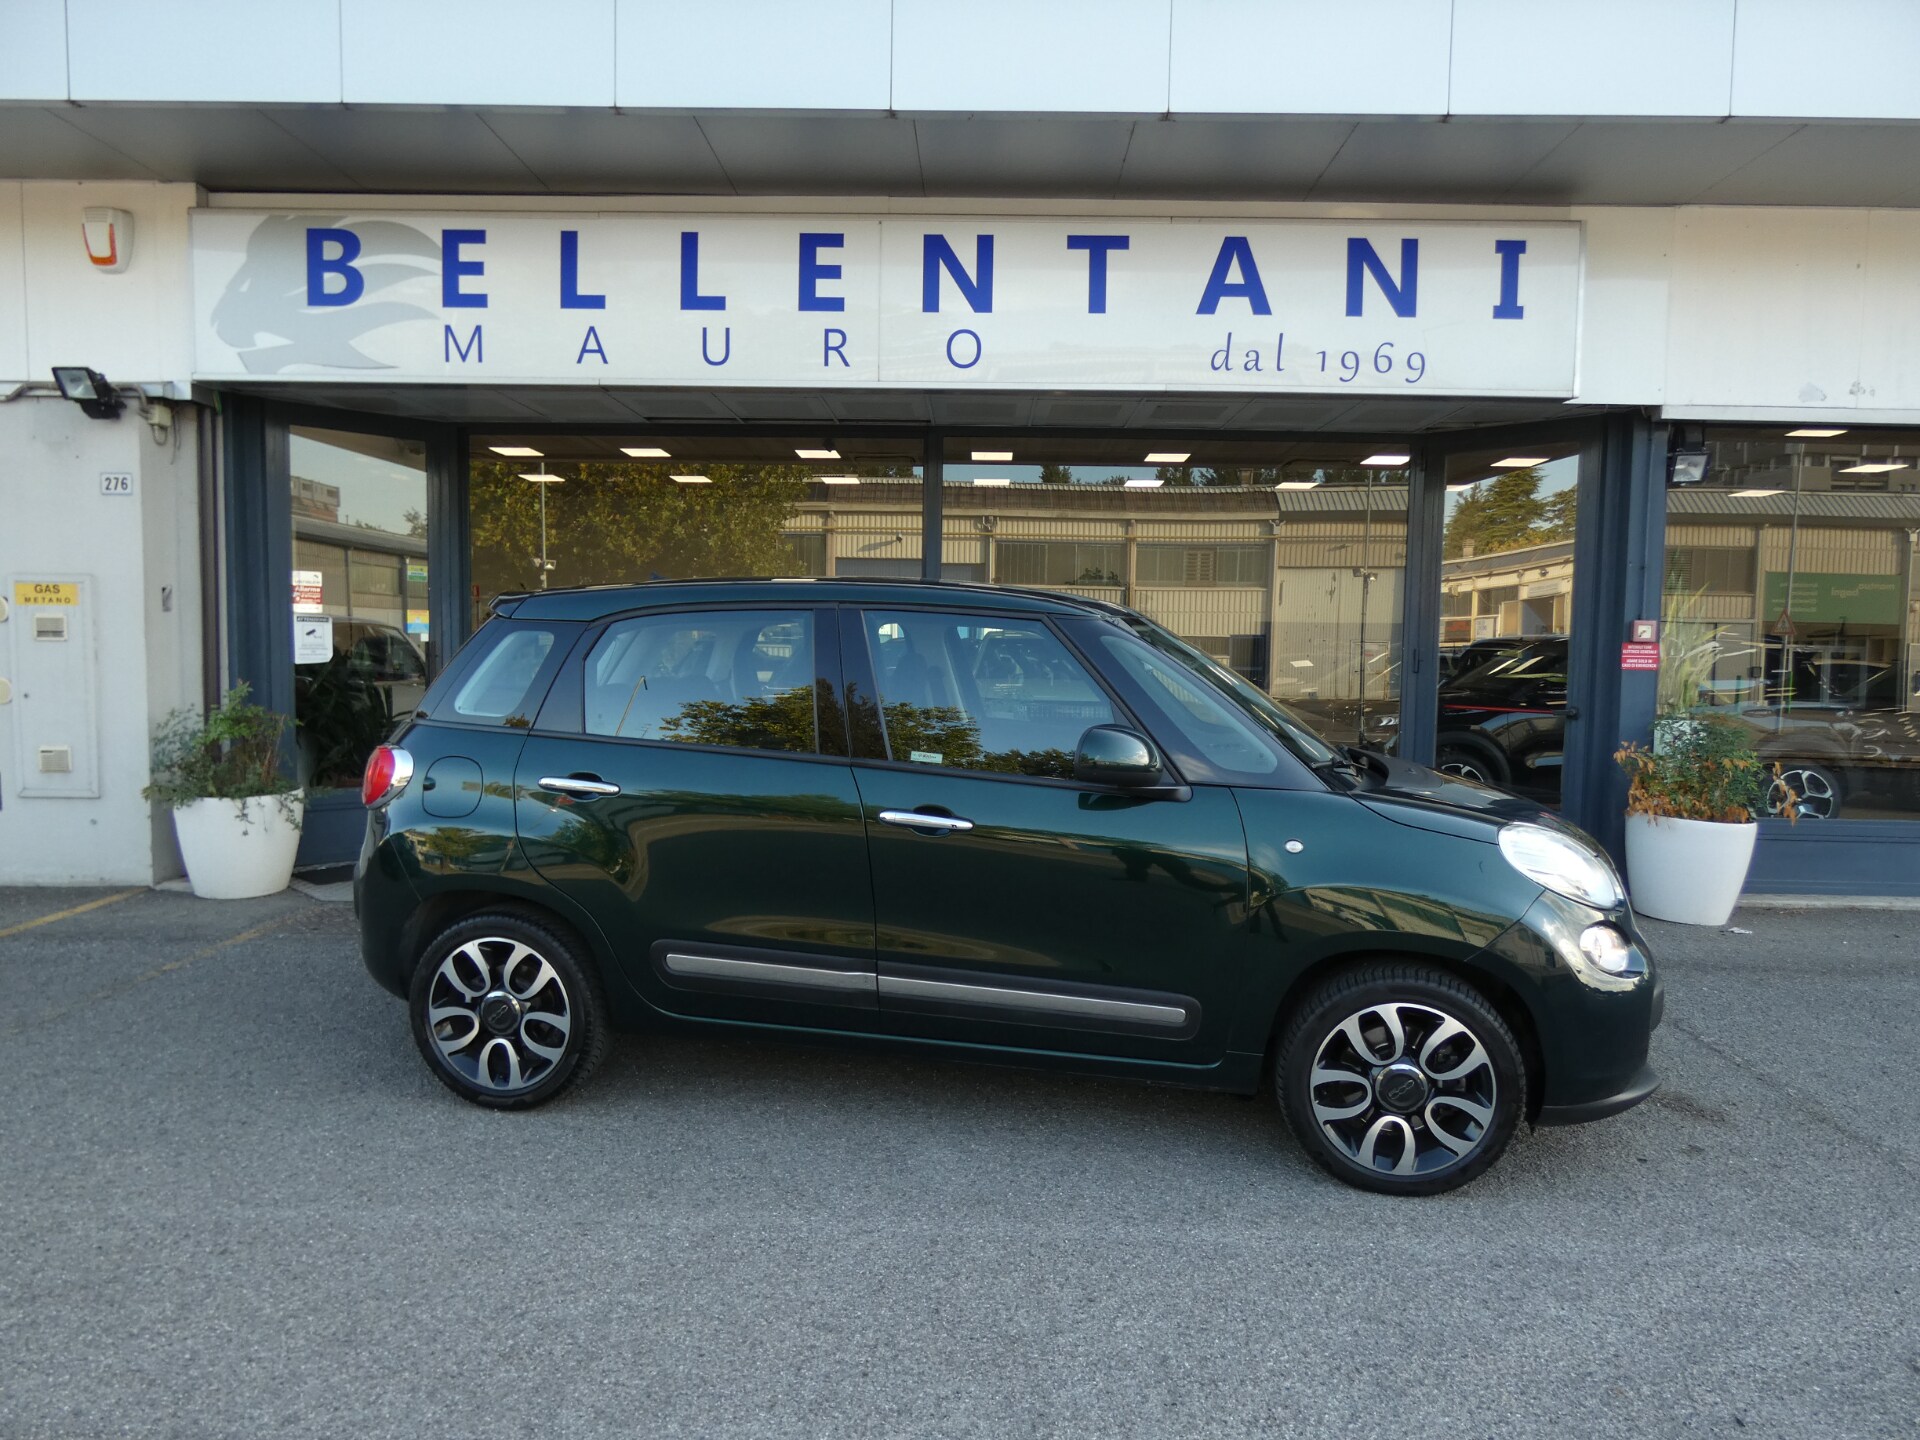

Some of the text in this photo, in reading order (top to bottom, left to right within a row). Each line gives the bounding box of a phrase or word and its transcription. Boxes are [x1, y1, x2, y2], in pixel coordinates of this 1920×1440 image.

[306, 228, 1527, 319] BELLENTANI
[444, 324, 982, 369] MAURO
[1210, 332, 1428, 384] dal 1969
[104, 476, 129, 491] 276
[33, 583, 61, 594] GAS
[23, 596, 72, 604] METANO
[1387, 1079, 1415, 1100] 500
